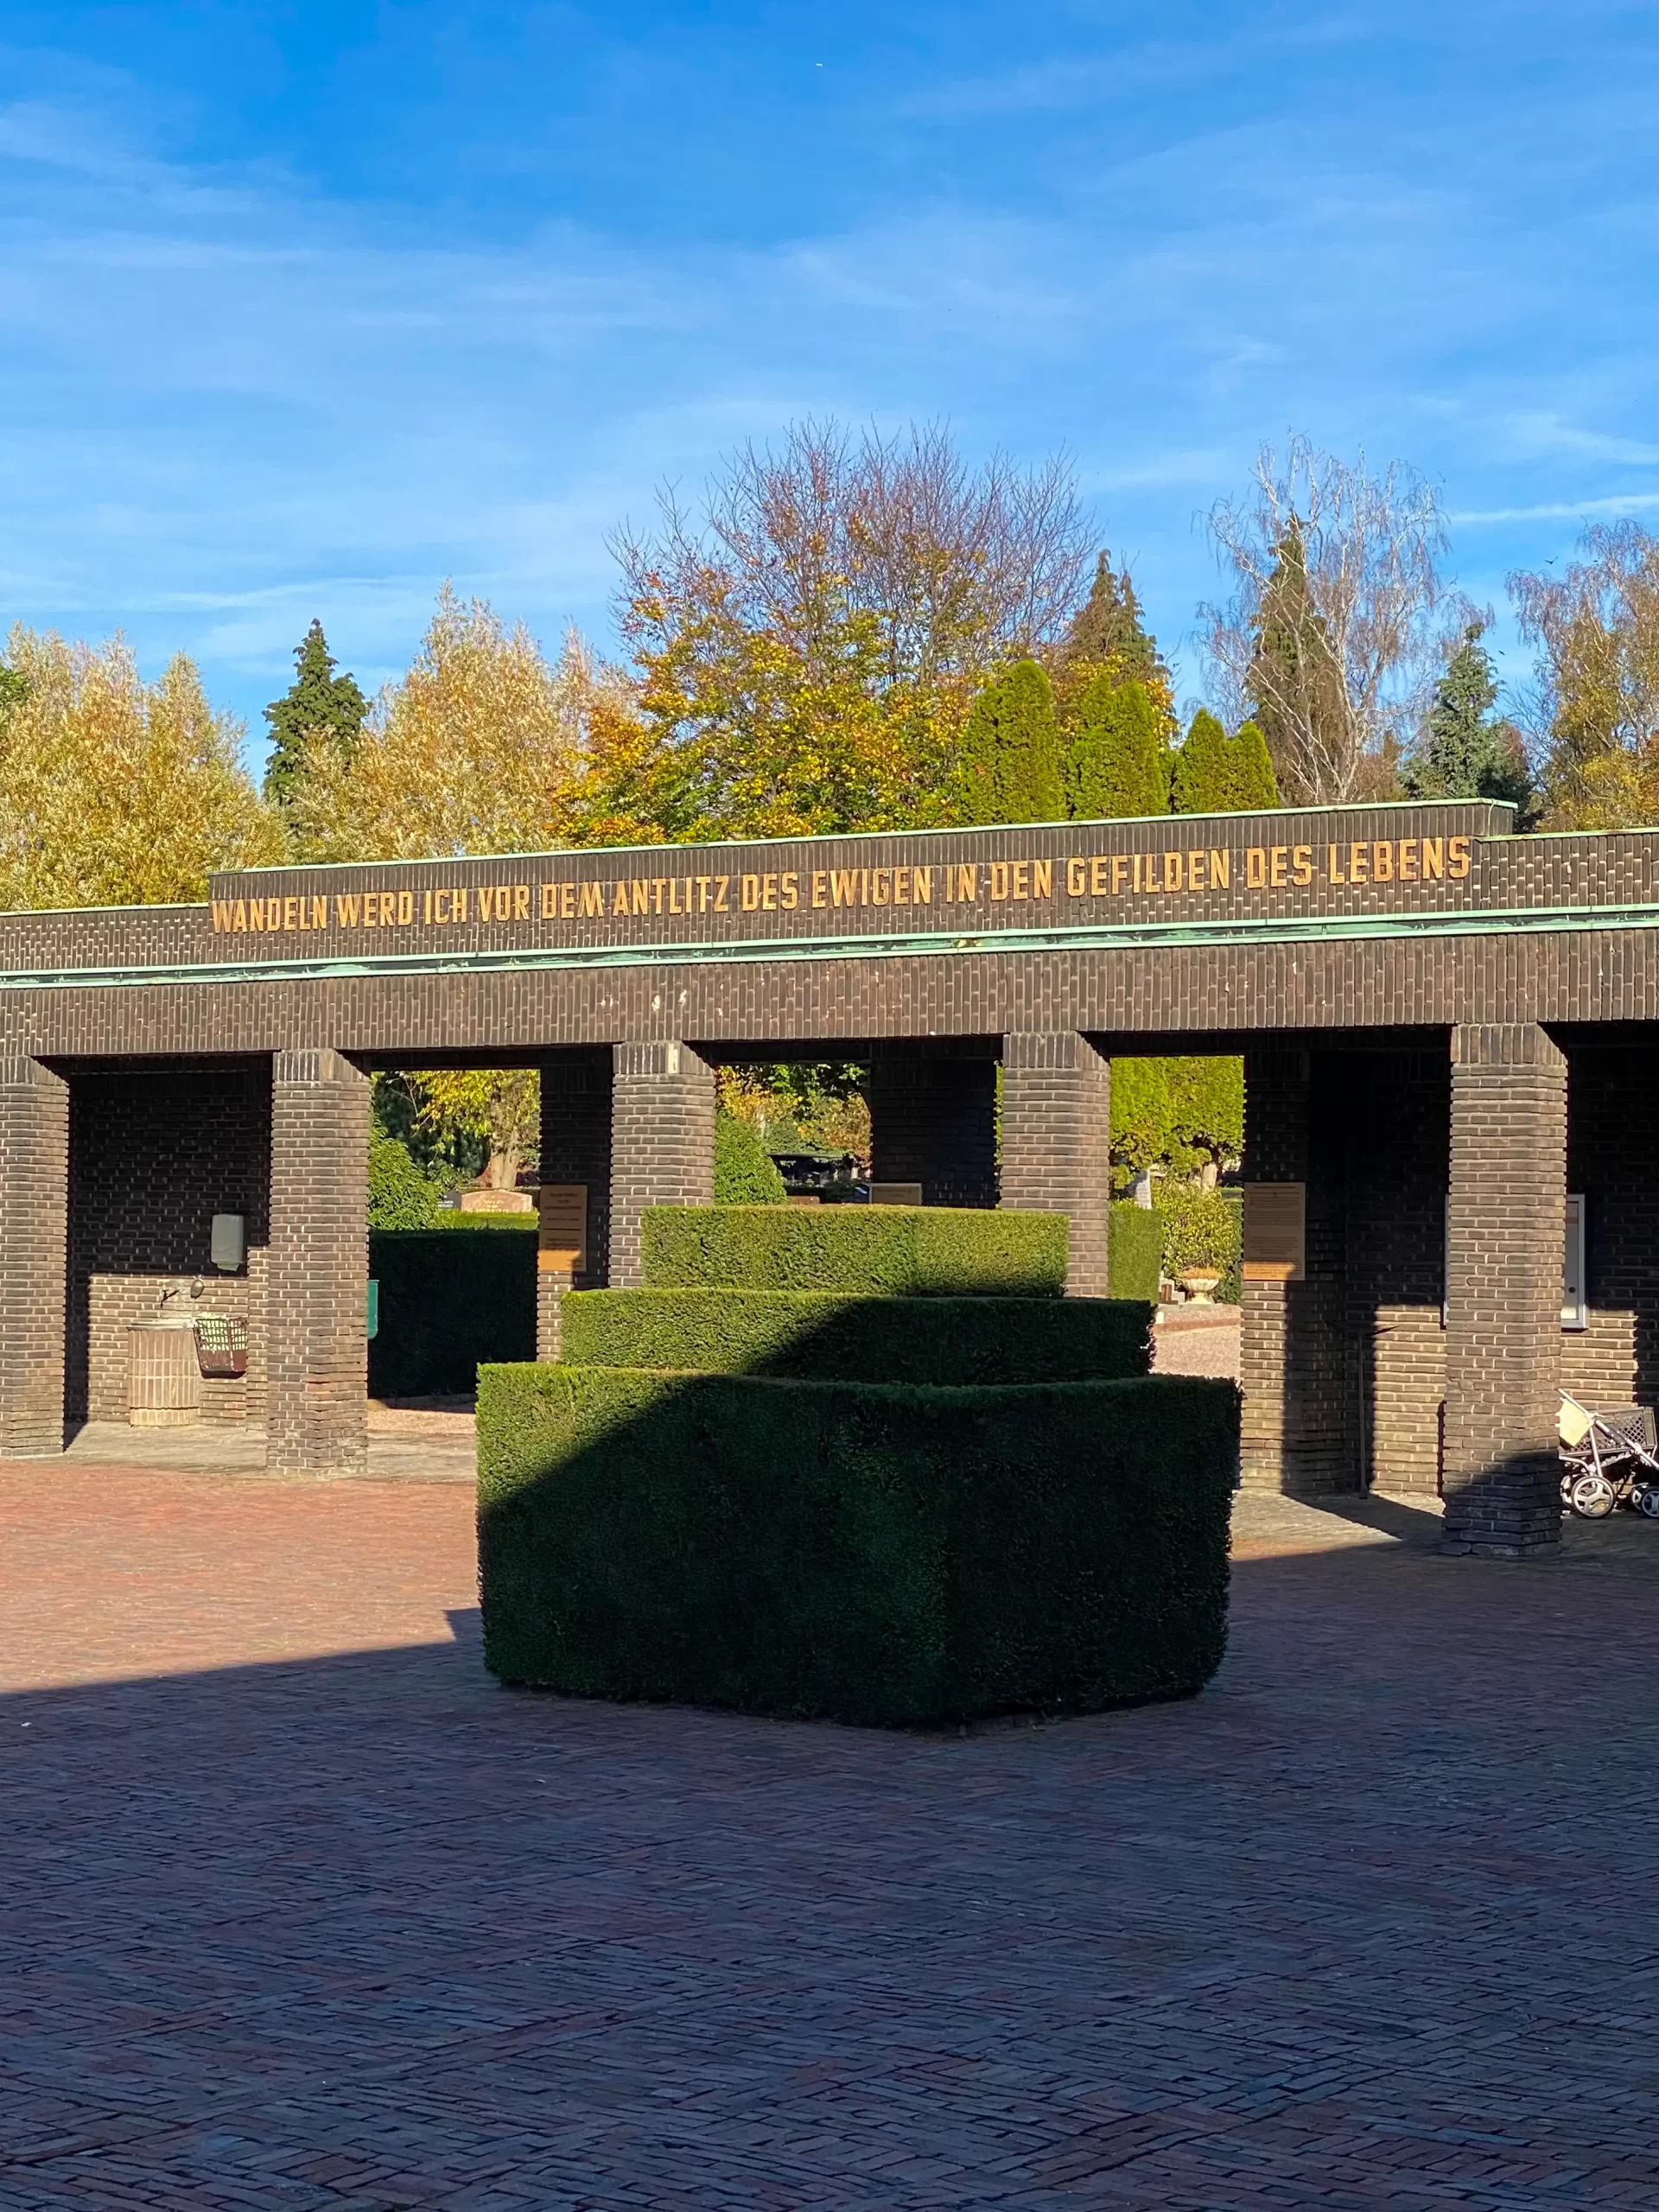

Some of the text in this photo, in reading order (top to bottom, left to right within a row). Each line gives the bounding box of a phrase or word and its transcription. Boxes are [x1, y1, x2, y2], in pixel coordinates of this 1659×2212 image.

[212, 836, 1470, 933] WANDELN WERD ICH VOR DEM ANTLITZ DES EWIGEN IN DEN GEFILDEN DES LEBENS
